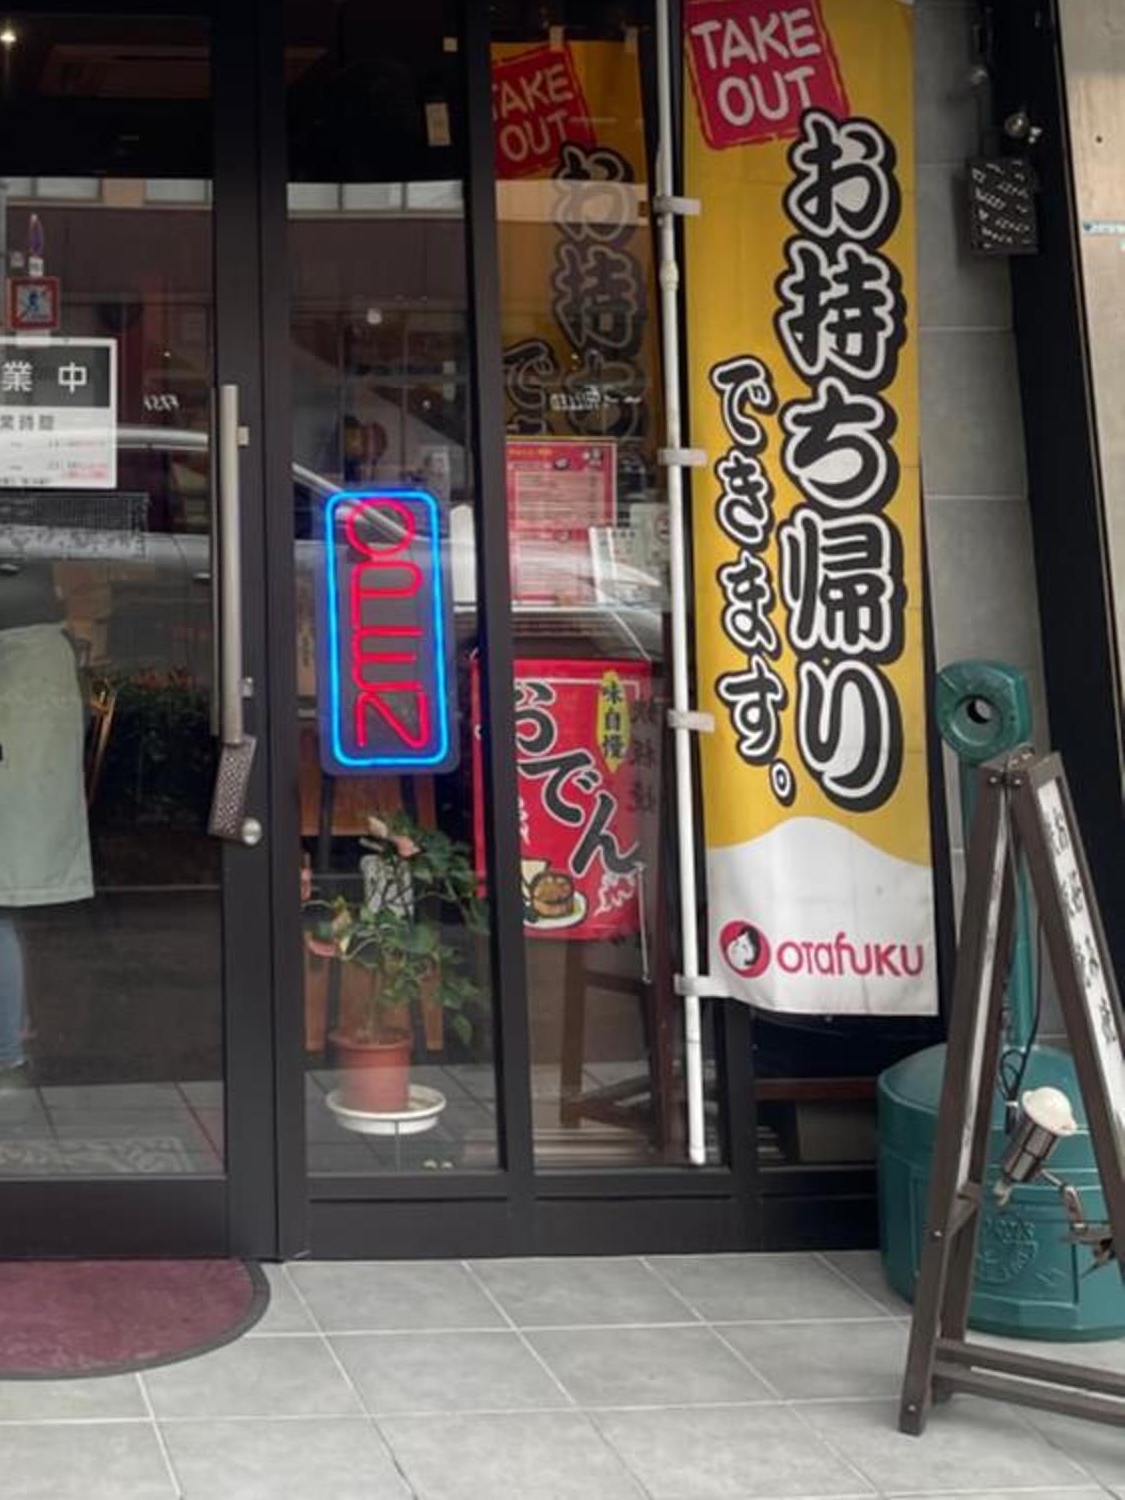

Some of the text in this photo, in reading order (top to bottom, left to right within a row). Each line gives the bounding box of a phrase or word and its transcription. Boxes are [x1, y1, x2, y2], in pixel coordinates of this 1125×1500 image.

[691, 8, 822, 70] TAKE
[717, 68, 817, 127] OUT
[499, 109, 570, 163] OUT
[774, 109, 906, 811] お持ち帰り
[346, 496, 430, 751] OPEN
[710, 356, 795, 806] できます。
